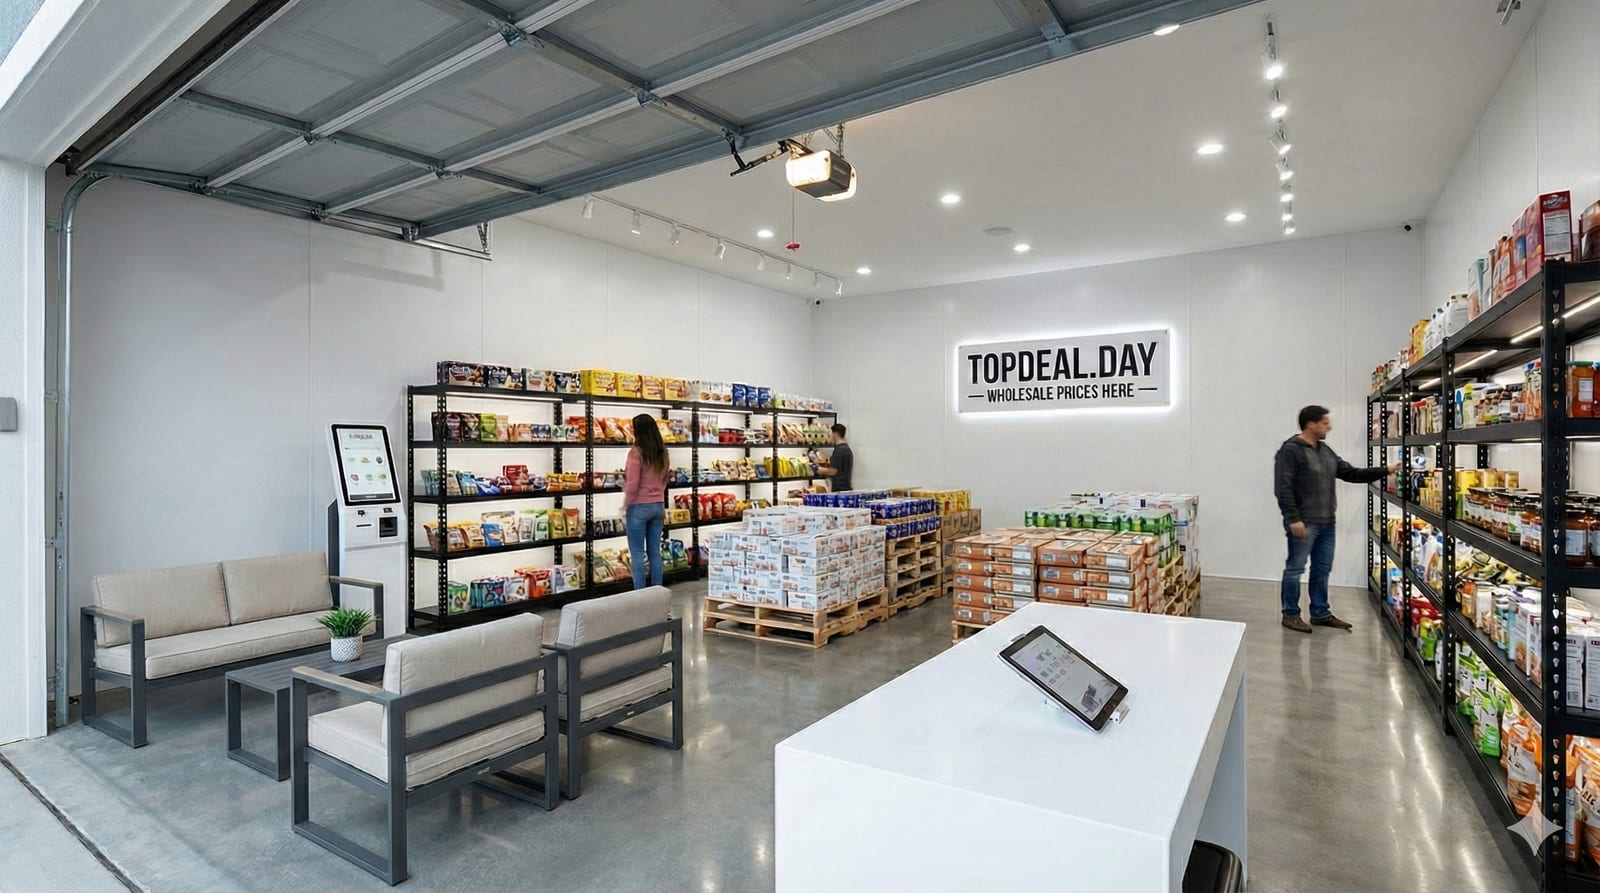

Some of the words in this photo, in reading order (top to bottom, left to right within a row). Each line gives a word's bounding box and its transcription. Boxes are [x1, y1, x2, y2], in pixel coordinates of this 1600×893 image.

[968, 342, 1157, 384] TOPDEAL.DAY
[987, 386, 1053, 403] WHOLESALE
[1057, 384, 1098, 400] PRICES
[1102, 383, 1135, 398] HERE
